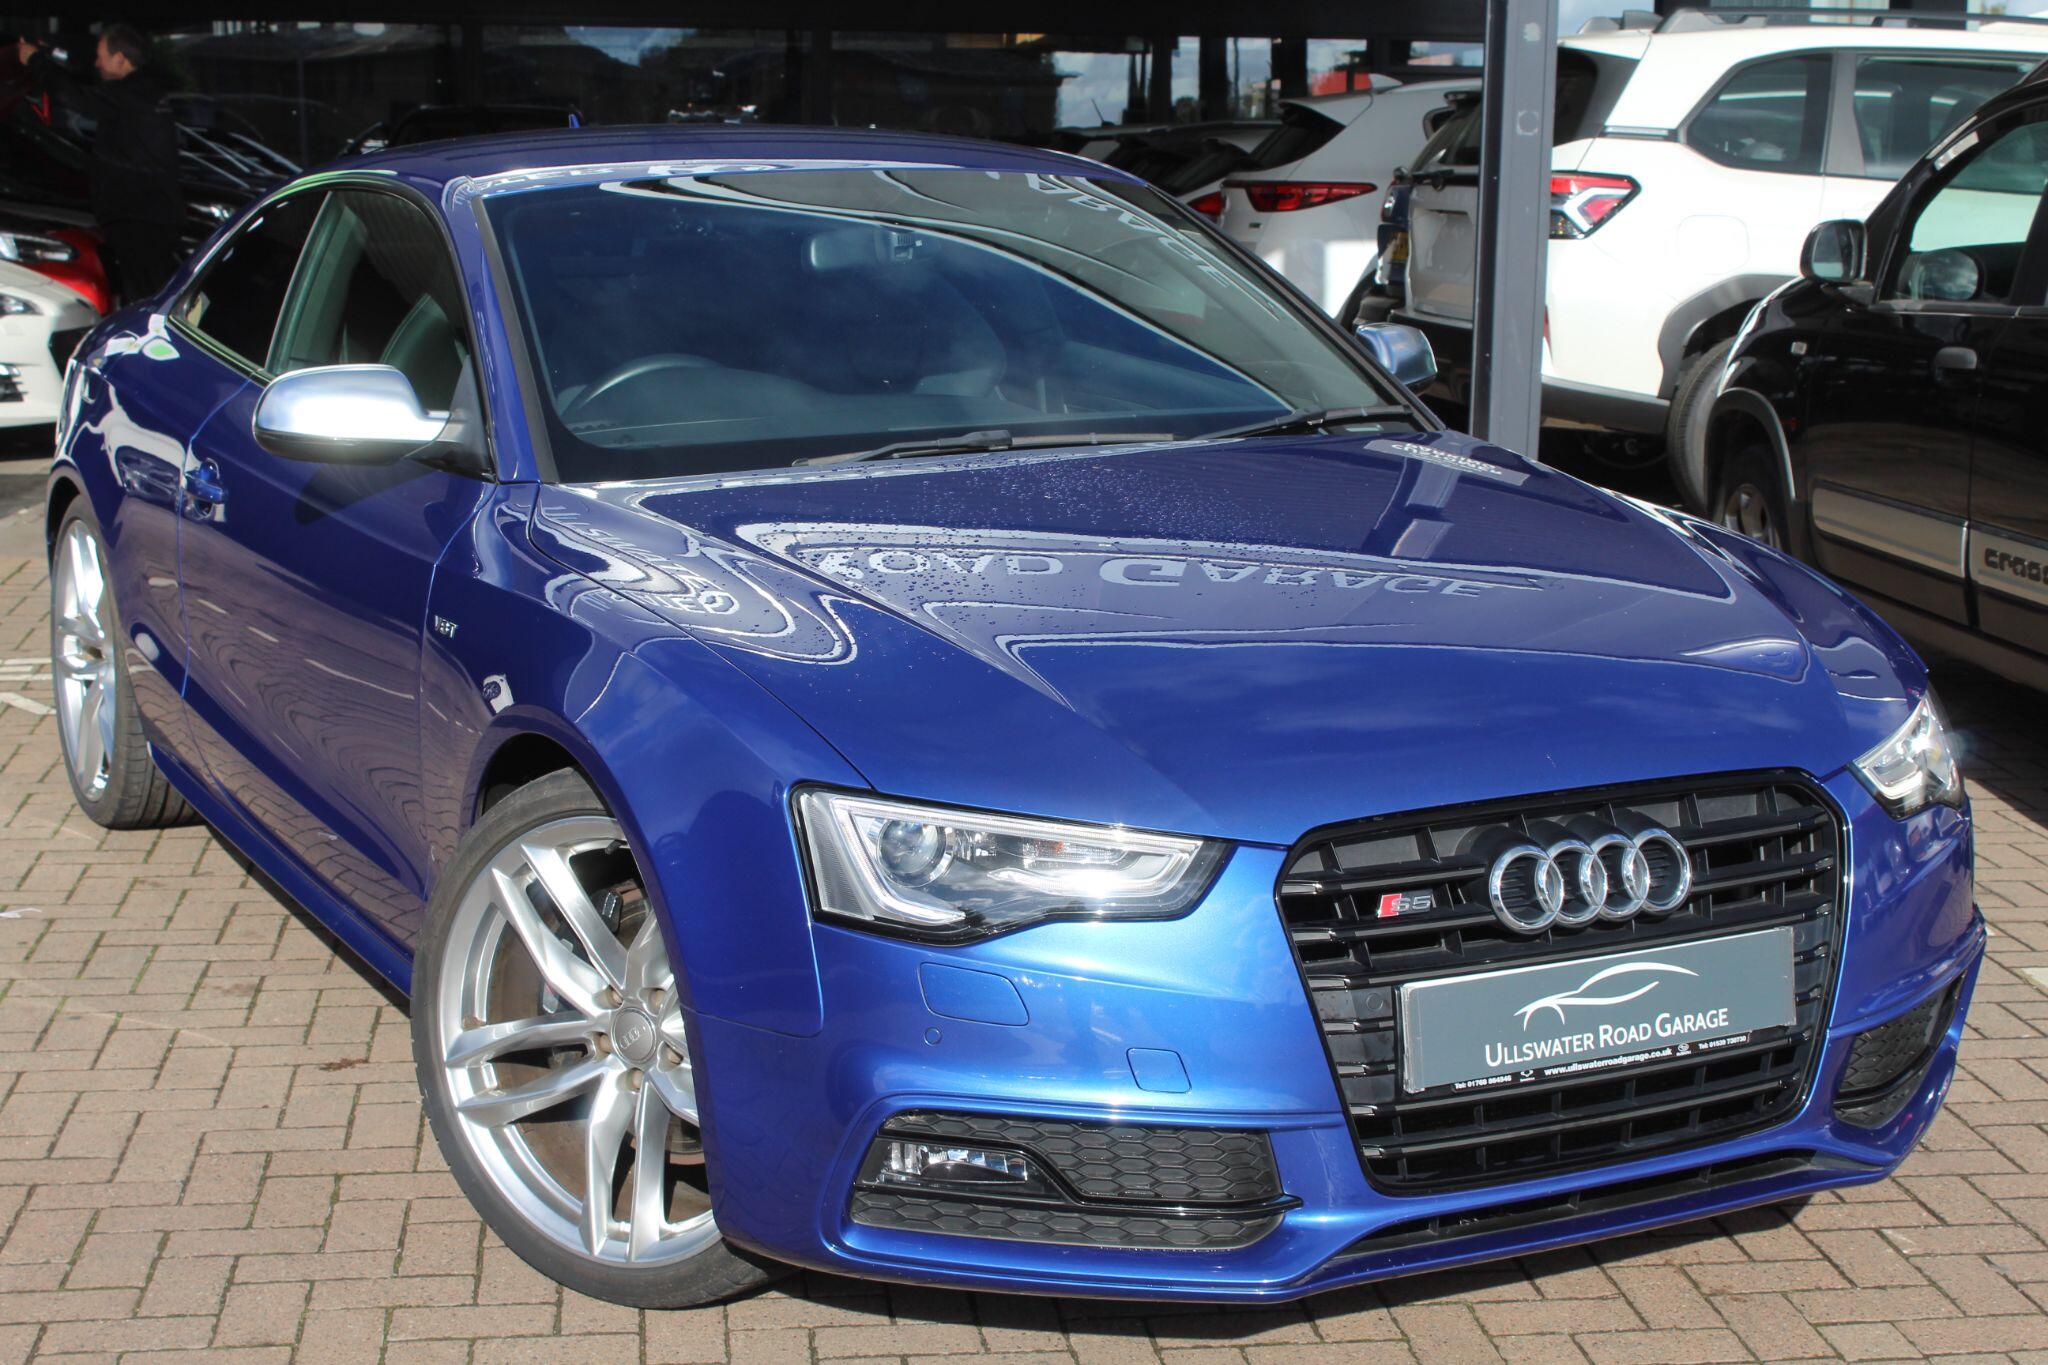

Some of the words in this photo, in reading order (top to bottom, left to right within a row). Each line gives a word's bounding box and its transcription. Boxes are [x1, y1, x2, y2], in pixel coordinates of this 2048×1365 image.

[1485, 1032, 1595, 1068] ULLSWATER
[1598, 1023, 1652, 1049] ROAD
[1655, 1008, 1729, 1038] GARAGE
[1544, 1048, 1673, 1076] www.ullswaterroadgarage.co.uk
